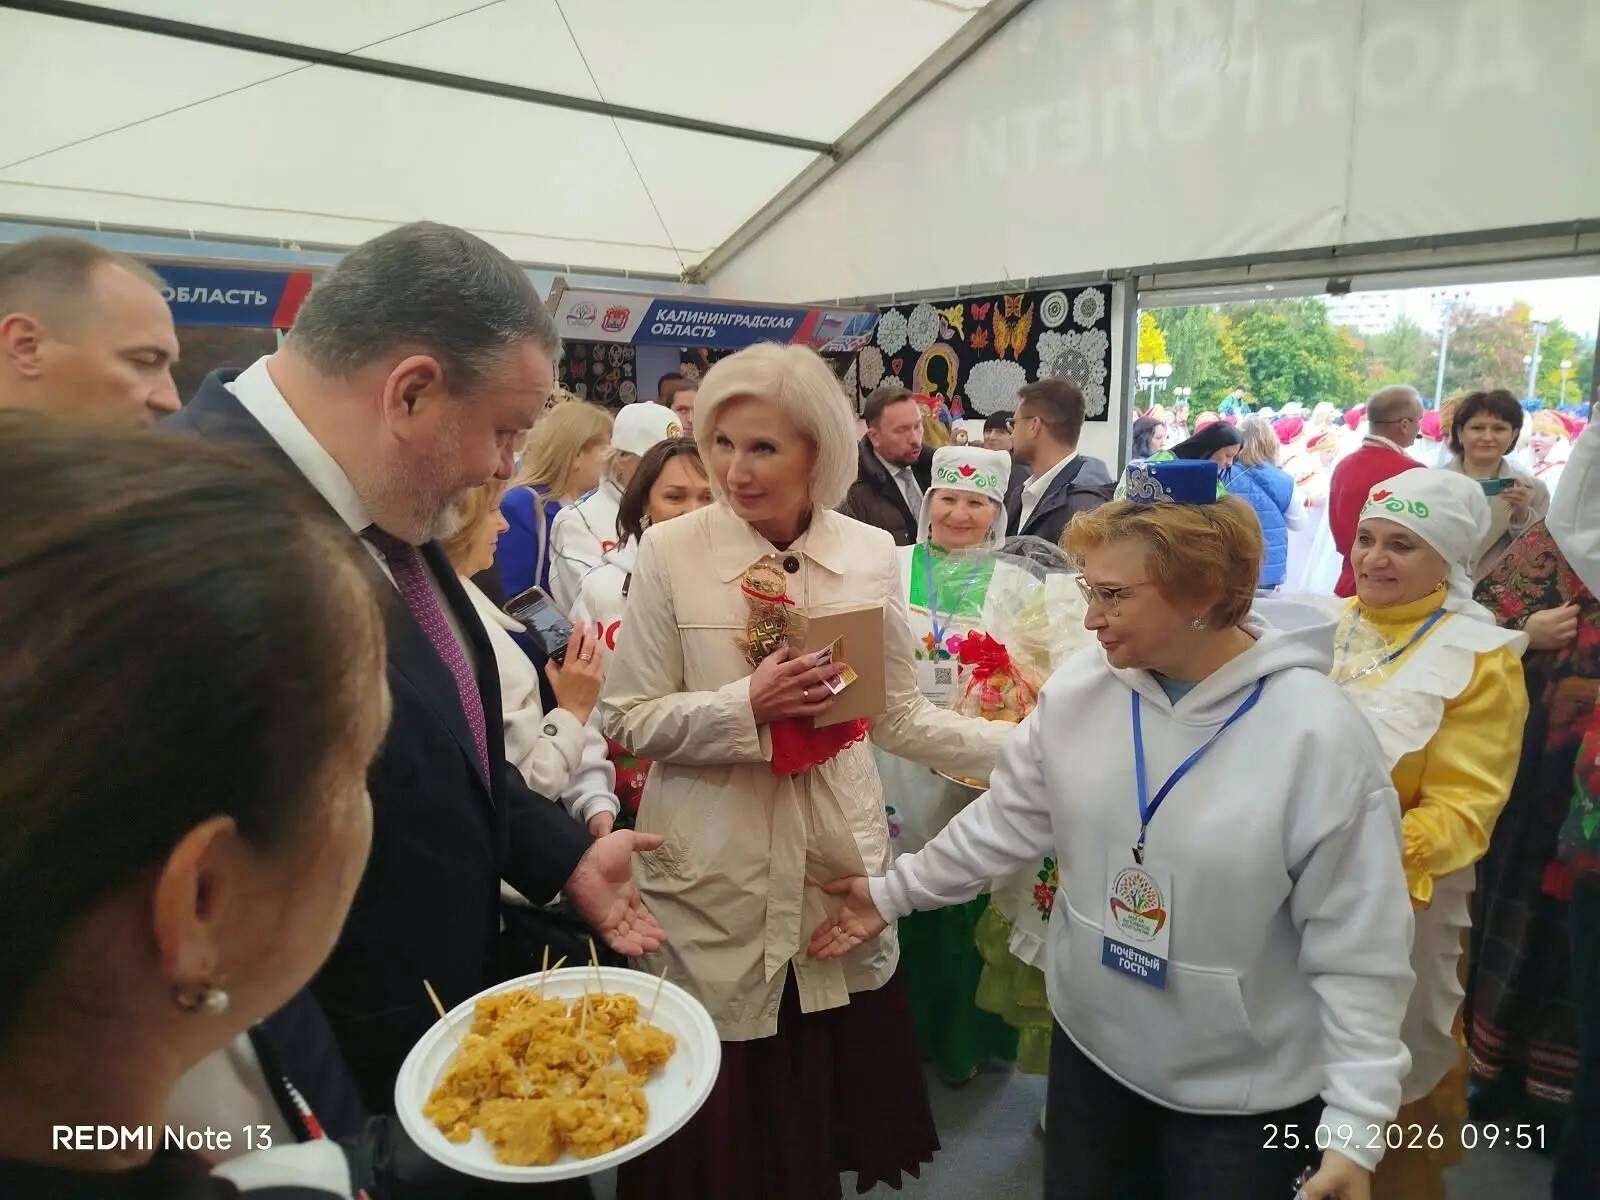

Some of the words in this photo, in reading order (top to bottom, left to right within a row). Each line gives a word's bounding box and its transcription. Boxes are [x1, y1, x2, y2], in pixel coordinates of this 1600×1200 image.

[161, 286, 267, 305] ОБЛАСТЬ
[655, 309, 794, 329] КАЛИНИНГРАДСКАЯ
[650, 323, 717, 338] ОБЛАСТЬ
[1109, 943, 1160, 971] ПОЧЁТНЫЙ
[1118, 957, 1148, 977] ГОСТЬ
